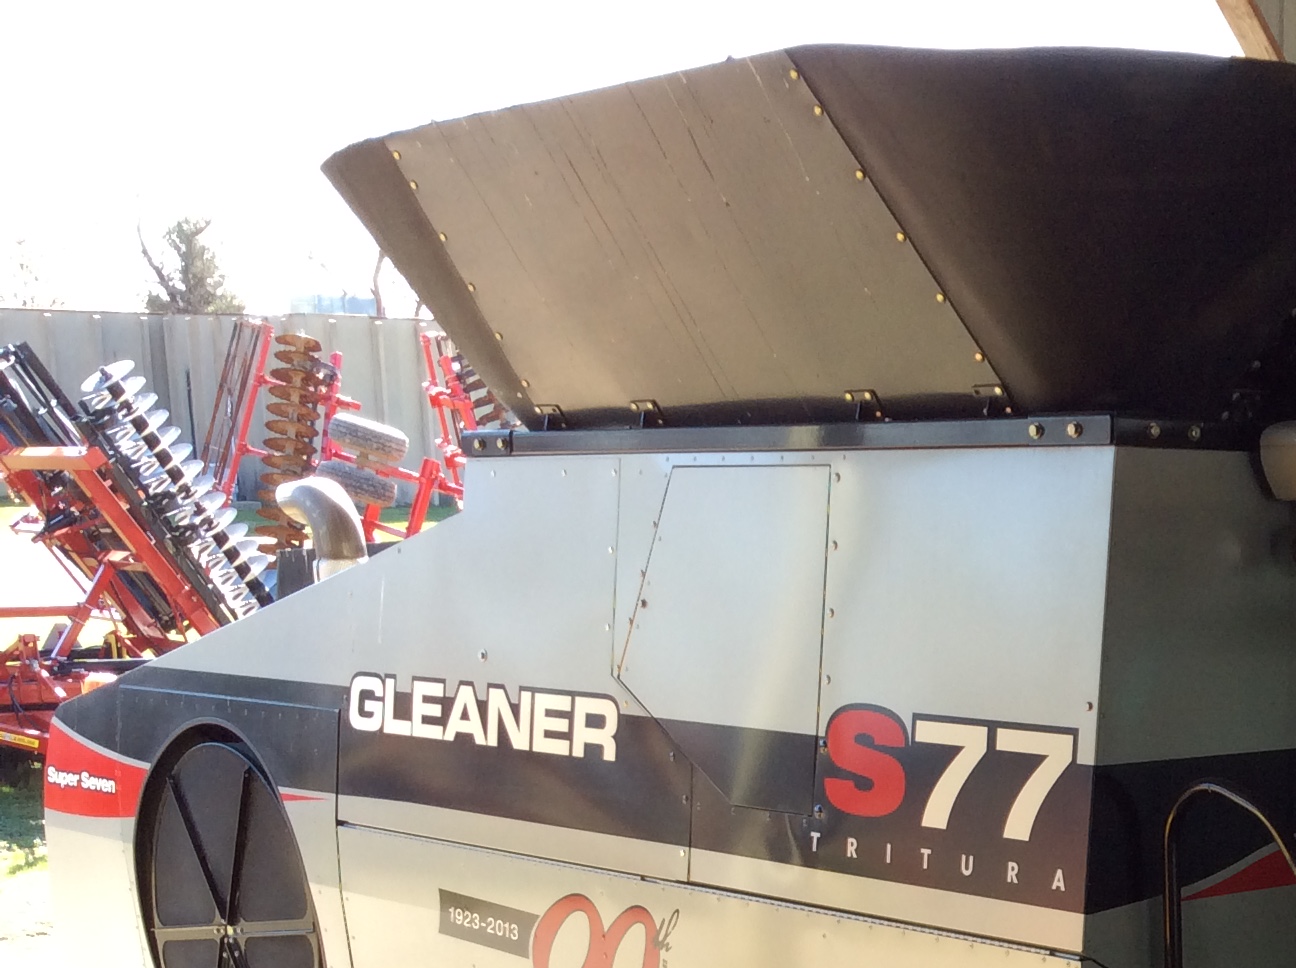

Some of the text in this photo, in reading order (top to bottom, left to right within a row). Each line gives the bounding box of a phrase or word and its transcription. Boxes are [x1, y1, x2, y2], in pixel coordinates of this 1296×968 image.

[347, 672, 620, 762] GLEANER
[47, 766, 116, 794] Super Seven
[823, 702, 1079, 842] S77
[810, 831, 1066, 891] TRITURA
[448, 906, 520, 941] 1923-2013
